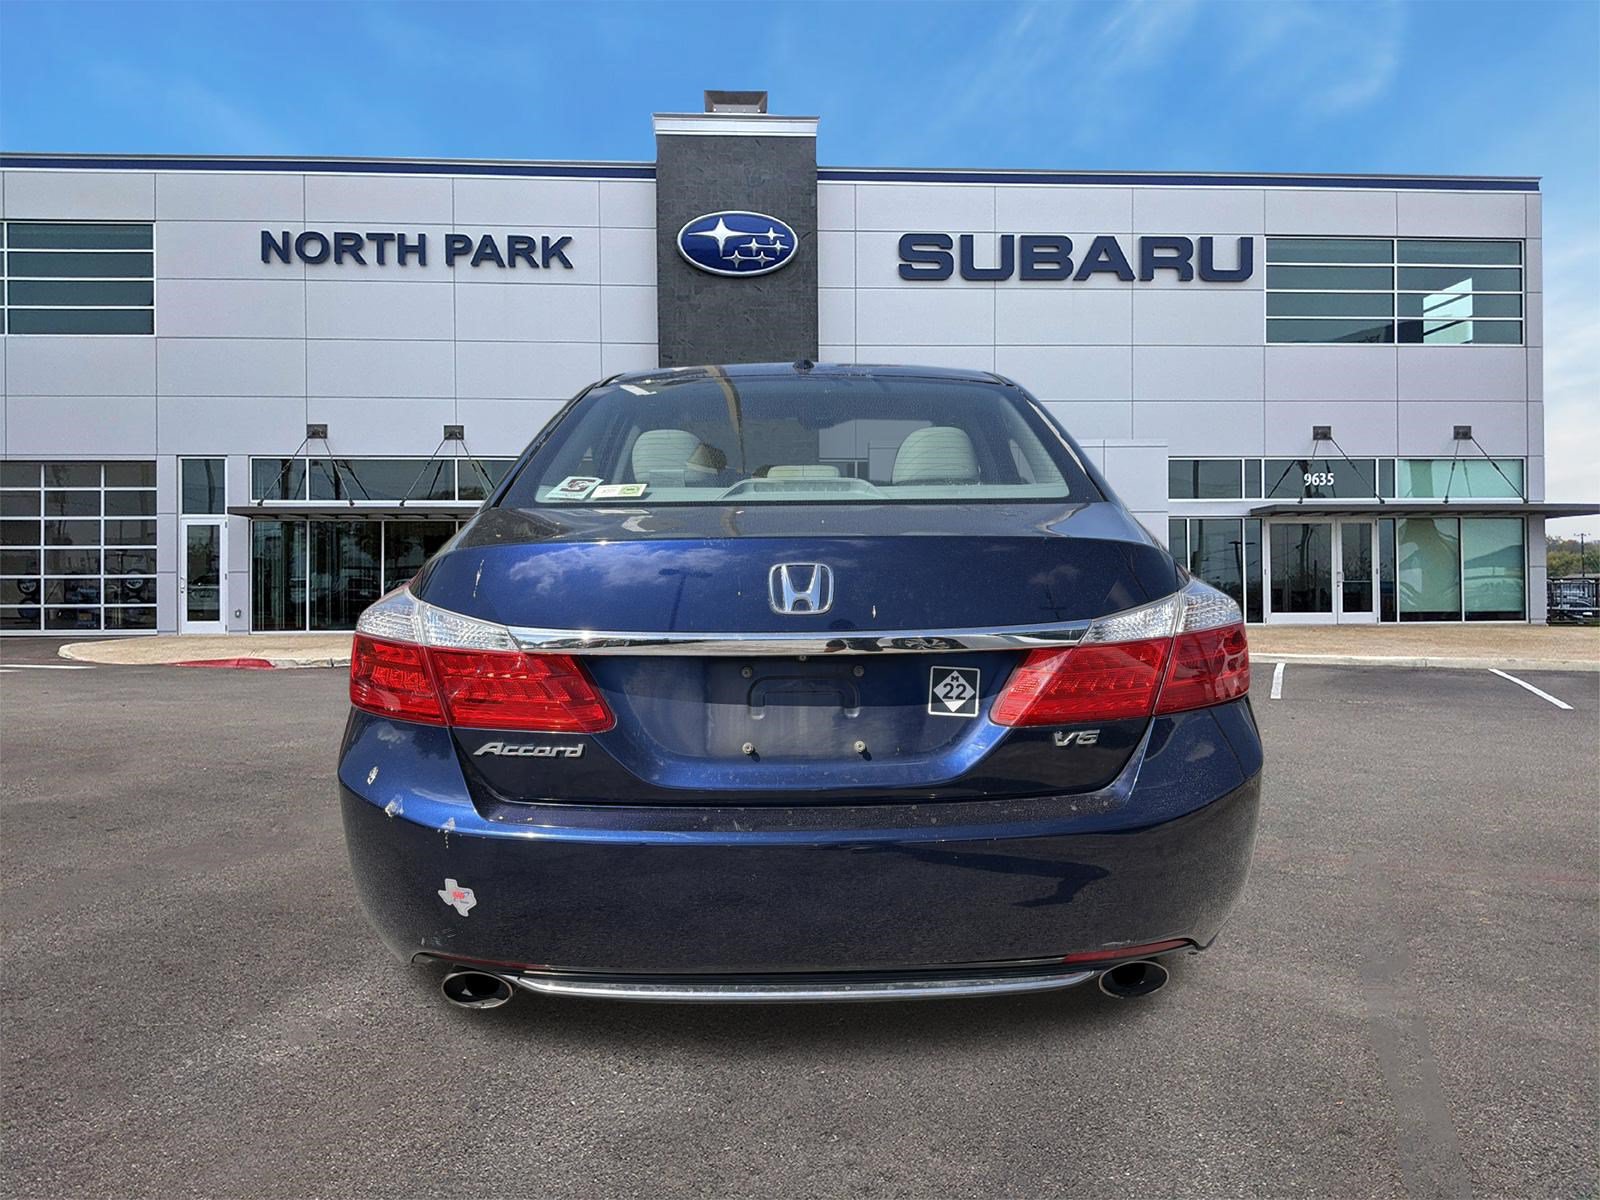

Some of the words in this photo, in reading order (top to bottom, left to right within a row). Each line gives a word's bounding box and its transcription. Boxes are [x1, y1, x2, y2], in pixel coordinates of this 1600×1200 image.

[261, 230, 427, 267] NORTH
[445, 233, 574, 269] PARK
[897, 233, 1254, 282] SUBARU
[1304, 473, 1334, 486] 9635
[942, 682, 967, 700] 22
[1053, 729, 1100, 747] V6
[473, 742, 583, 757] Accord
